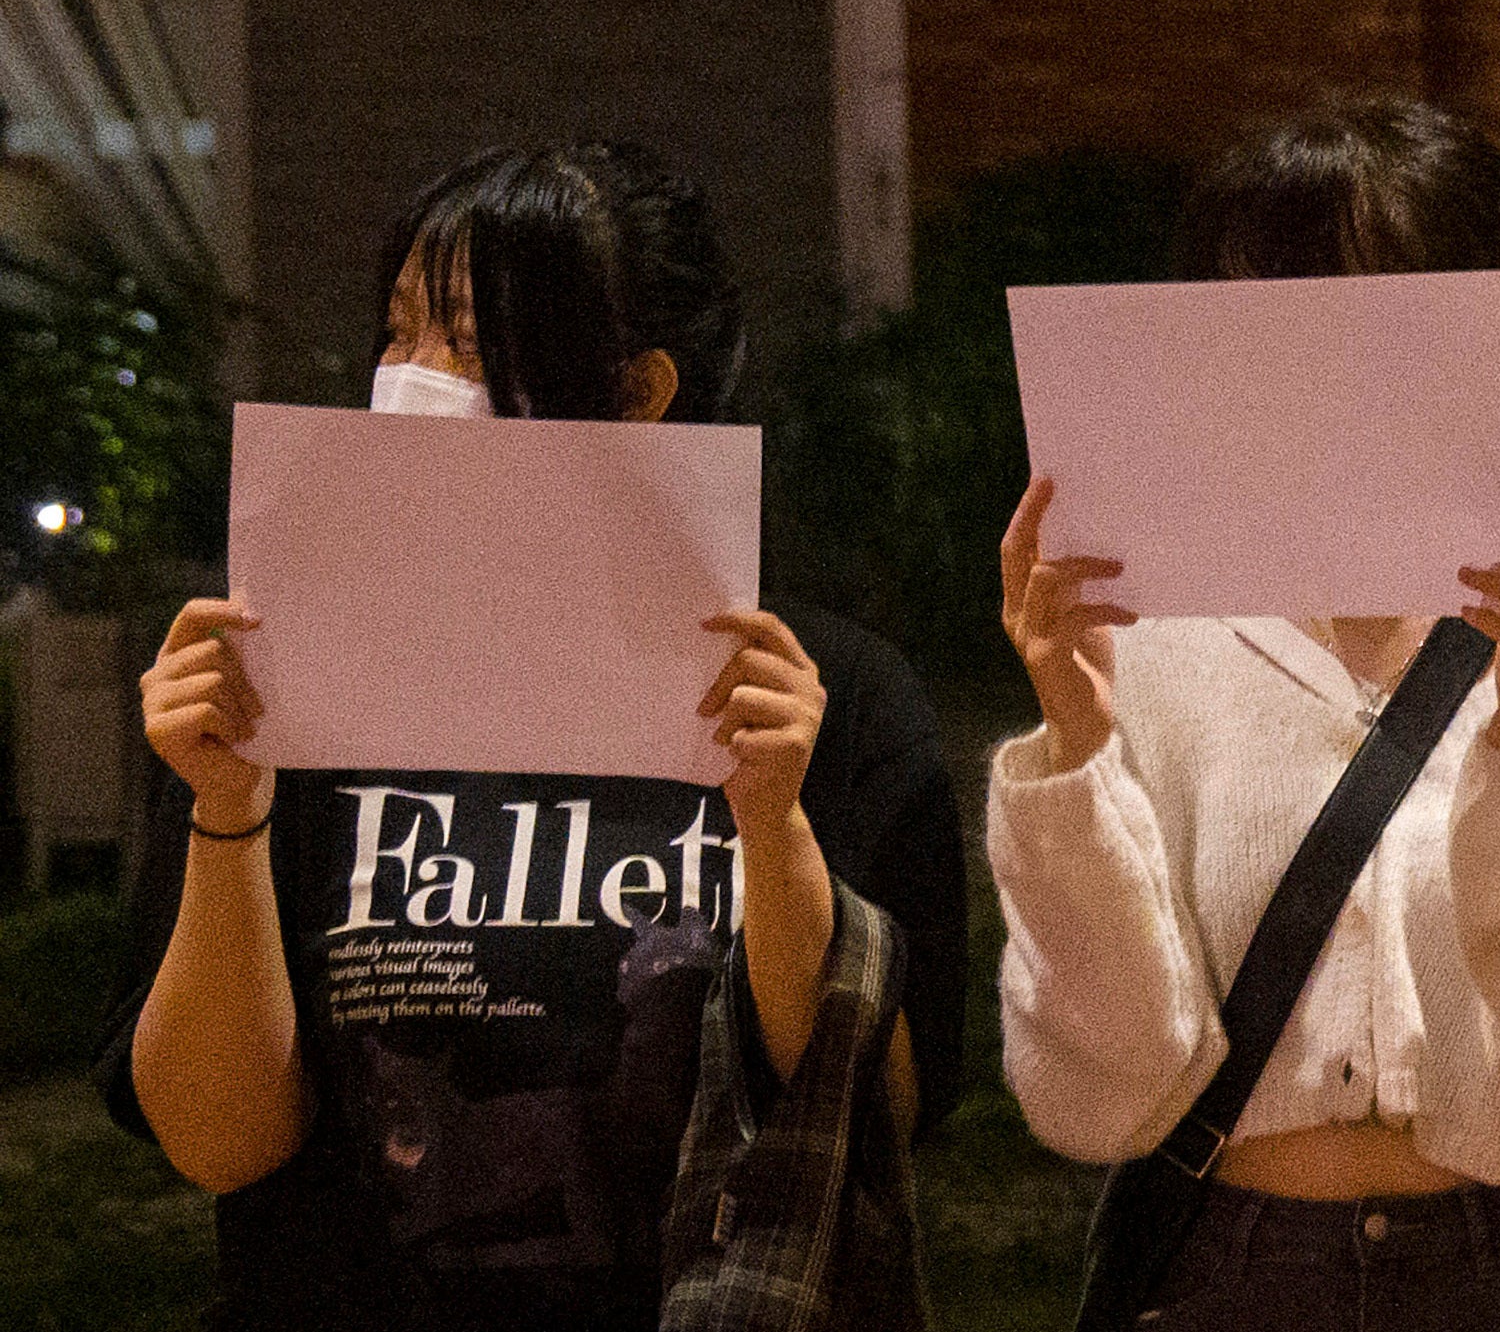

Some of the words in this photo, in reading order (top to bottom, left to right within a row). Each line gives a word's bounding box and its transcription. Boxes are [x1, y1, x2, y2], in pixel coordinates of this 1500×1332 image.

[387, 938, 475, 960] reinterprets
[374, 956, 419, 975] visual
[422, 958, 475, 981] images
[379, 981, 405, 996] can
[409, 976, 489, 1001] ceaselessly
[393, 997, 431, 1017] them
[434, 1002, 454, 1016] on
[459, 996, 483, 1016] the
